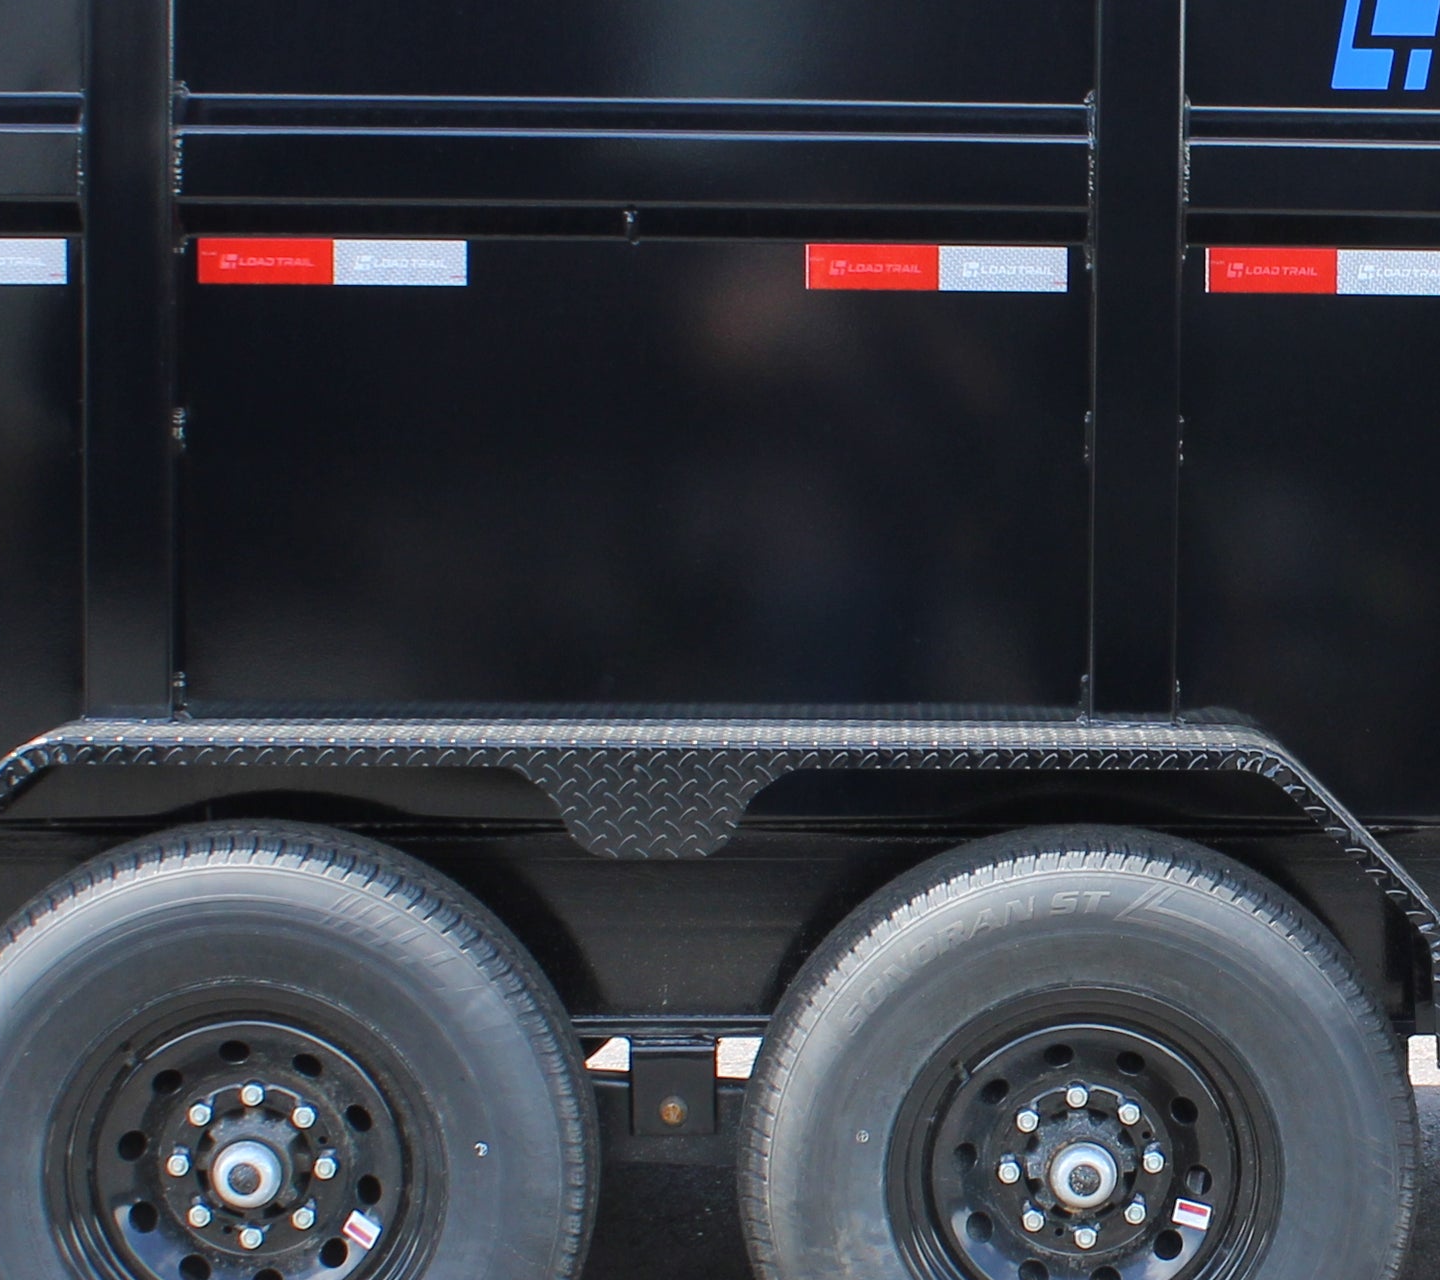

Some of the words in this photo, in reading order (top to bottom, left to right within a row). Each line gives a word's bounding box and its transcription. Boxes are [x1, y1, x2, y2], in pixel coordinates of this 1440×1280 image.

[1245, 266, 1280, 276] LOAD
[1281, 266, 1318, 276] TRAIL
[1048, 891, 1112, 915] ST
